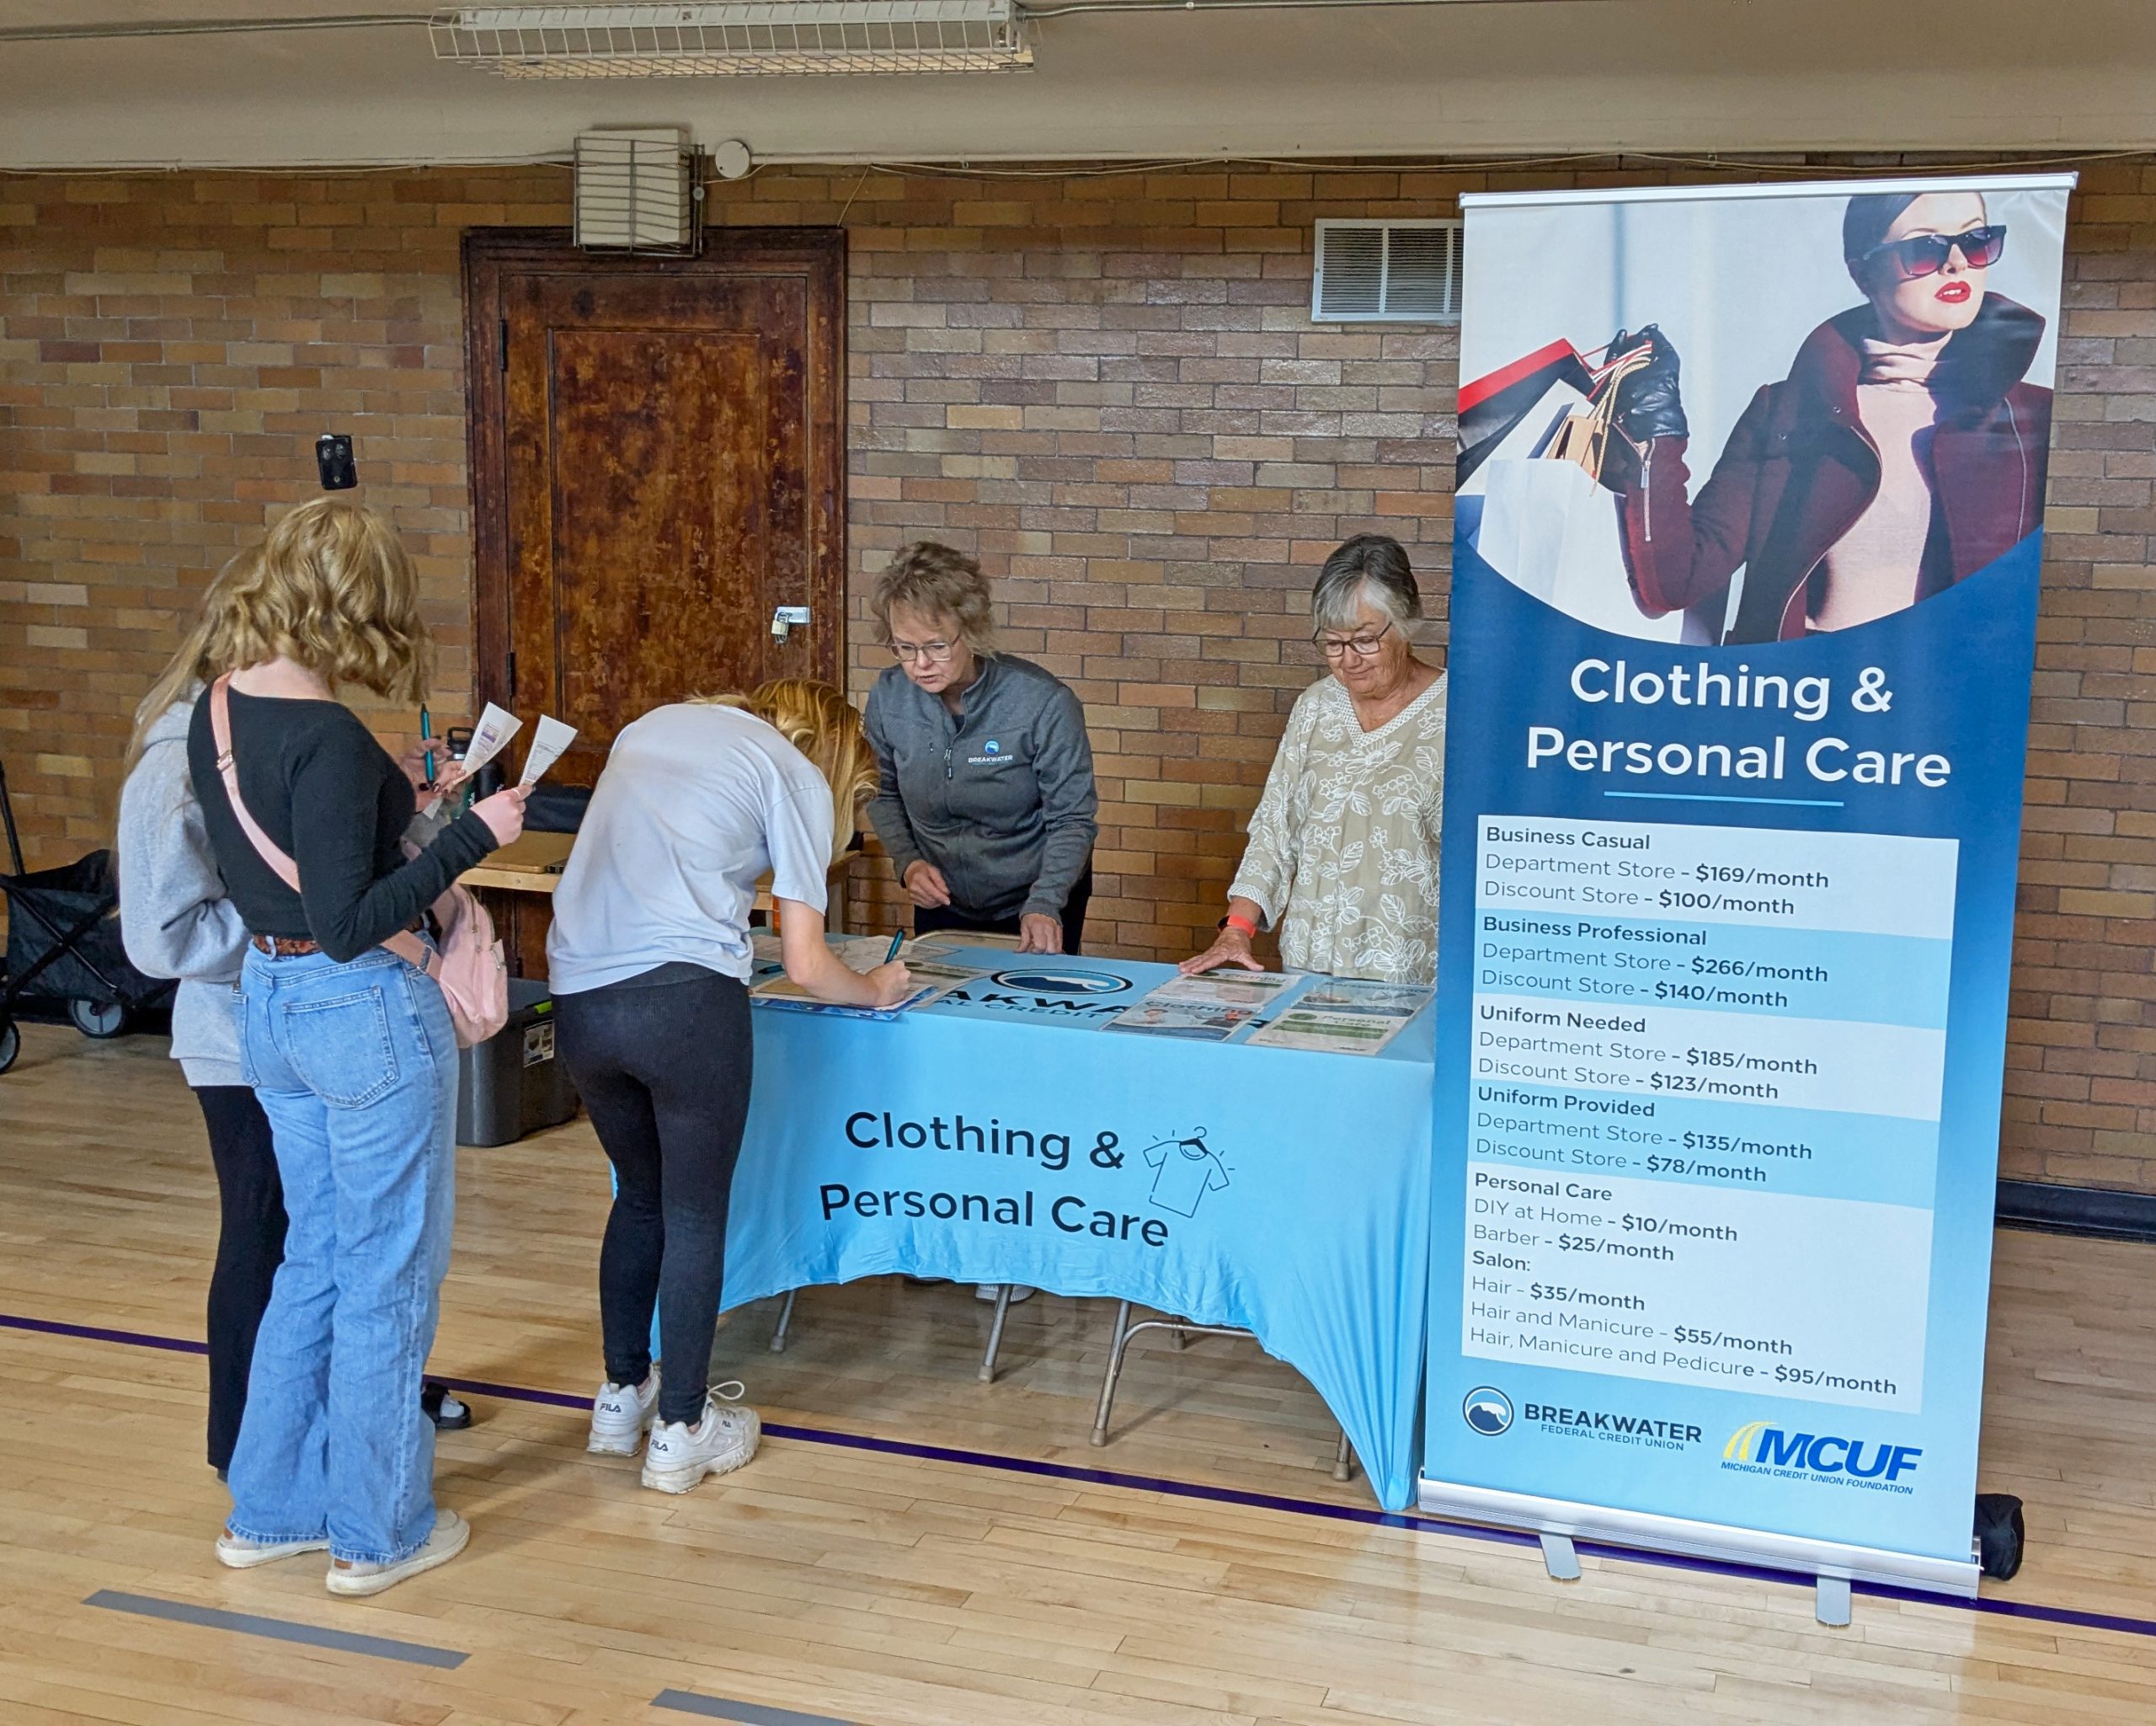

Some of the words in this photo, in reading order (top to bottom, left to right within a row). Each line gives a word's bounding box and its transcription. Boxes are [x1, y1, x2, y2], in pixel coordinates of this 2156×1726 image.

[1571, 658, 1830, 721] Clothing
[1851, 666, 1893, 713] &
[968, 755, 1013, 763] BREAKWATER
[1527, 726, 1785, 780] Personal
[1806, 736, 1951, 788] Care
[1486, 826, 1576, 846] Business
[1581, 831, 1651, 850] Casual
[1486, 852, 1612, 876] Department
[1616, 860, 1676, 879] Store
[1694, 862, 1829, 889] $169/month
[1485, 880, 1577, 901] Discount
[1581, 885, 1639, 906] Store
[1658, 888, 1795, 915] $100/month
[1483, 916, 1572, 937] Business
[1577, 922, 1707, 946] Professional
[1482, 943, 1609, 967] Department
[1613, 952, 1672, 971] Store
[1690, 954, 1828, 983] $266/month
[1481, 969, 1573, 992] Discount
[1577, 976, 1636, 997] Store
[1654, 980, 1788, 1008] $140/month
[984, 1003, 1104, 1018] CREDIT
[1480, 1004, 1561, 1027] Uniform
[1566, 1011, 1646, 1034] Needed
[1479, 1031, 1604, 1057] Department
[1609, 1042, 1667, 1062] Store
[1685, 1046, 1817, 1076] $185/month
[1479, 1057, 1568, 1082] Discount
[1573, 1066, 1630, 1087] Store
[1649, 1071, 1779, 1099] $123/month
[1478, 1086, 1558, 1109] Uniform
[1563, 1094, 1656, 1118] Provided
[845, 1111, 1070, 1171] Clothing
[1089, 1130, 1125, 1170] &
[1477, 1112, 1601, 1140] Department
[1605, 1125, 1663, 1146] Store
[1681, 1130, 1812, 1160] $135/month
[1476, 1138, 1566, 1163] Discount
[1571, 1148, 1627, 1168] Store
[1646, 1153, 1767, 1183] $78/month
[1475, 1172, 1560, 1197] Personal
[1565, 1183, 1613, 1201] Care
[819, 1184, 1033, 1226] Personal
[1051, 1195, 1169, 1247] Care
[1474, 1198, 1510, 1216] DIY
[1514, 1205, 1534, 1221] at
[1540, 1205, 1603, 1227] Home
[1620, 1212, 1737, 1242] $10/month
[1471, 1249, 1531, 1272] Salon:
[1474, 1223, 1541, 1247] Barber
[1558, 1232, 1674, 1262] $25/month
[1472, 1274, 1513, 1295] Hair
[1529, 1281, 1645, 1312] $35/month
[1471, 1301, 1512, 1321] Hair
[1515, 1311, 1553, 1327] and
[1558, 1312, 1654, 1339] Manicure
[1673, 1324, 1793, 1355] $55/month
[1470, 1326, 1513, 1349] Hair,
[1518, 1333, 1614, 1360] Manicure
[1618, 1349, 1657, 1365] and
[1662, 1350, 1755, 1377] Pedicure
[1774, 1363, 1897, 1396] $95/month
[600, 1403, 622, 1413] FILA
[1524, 1403, 1702, 1444] BREAKWATER
[650, 1439, 669, 1452] FILA
[1540, 1423, 1596, 1440] FEDERAL
[1598, 1431, 1642, 1445] CREDIT
[1644, 1437, 1684, 1451] UNION
[1754, 1428, 1923, 1481] MCUF
[1720, 1461, 1772, 1476] MICHIGAN
[1772, 1468, 1810, 1481] CREDIT
[1810, 1473, 1845, 1486] UNION
[1845, 1478, 1914, 1495] FOUNDATION
